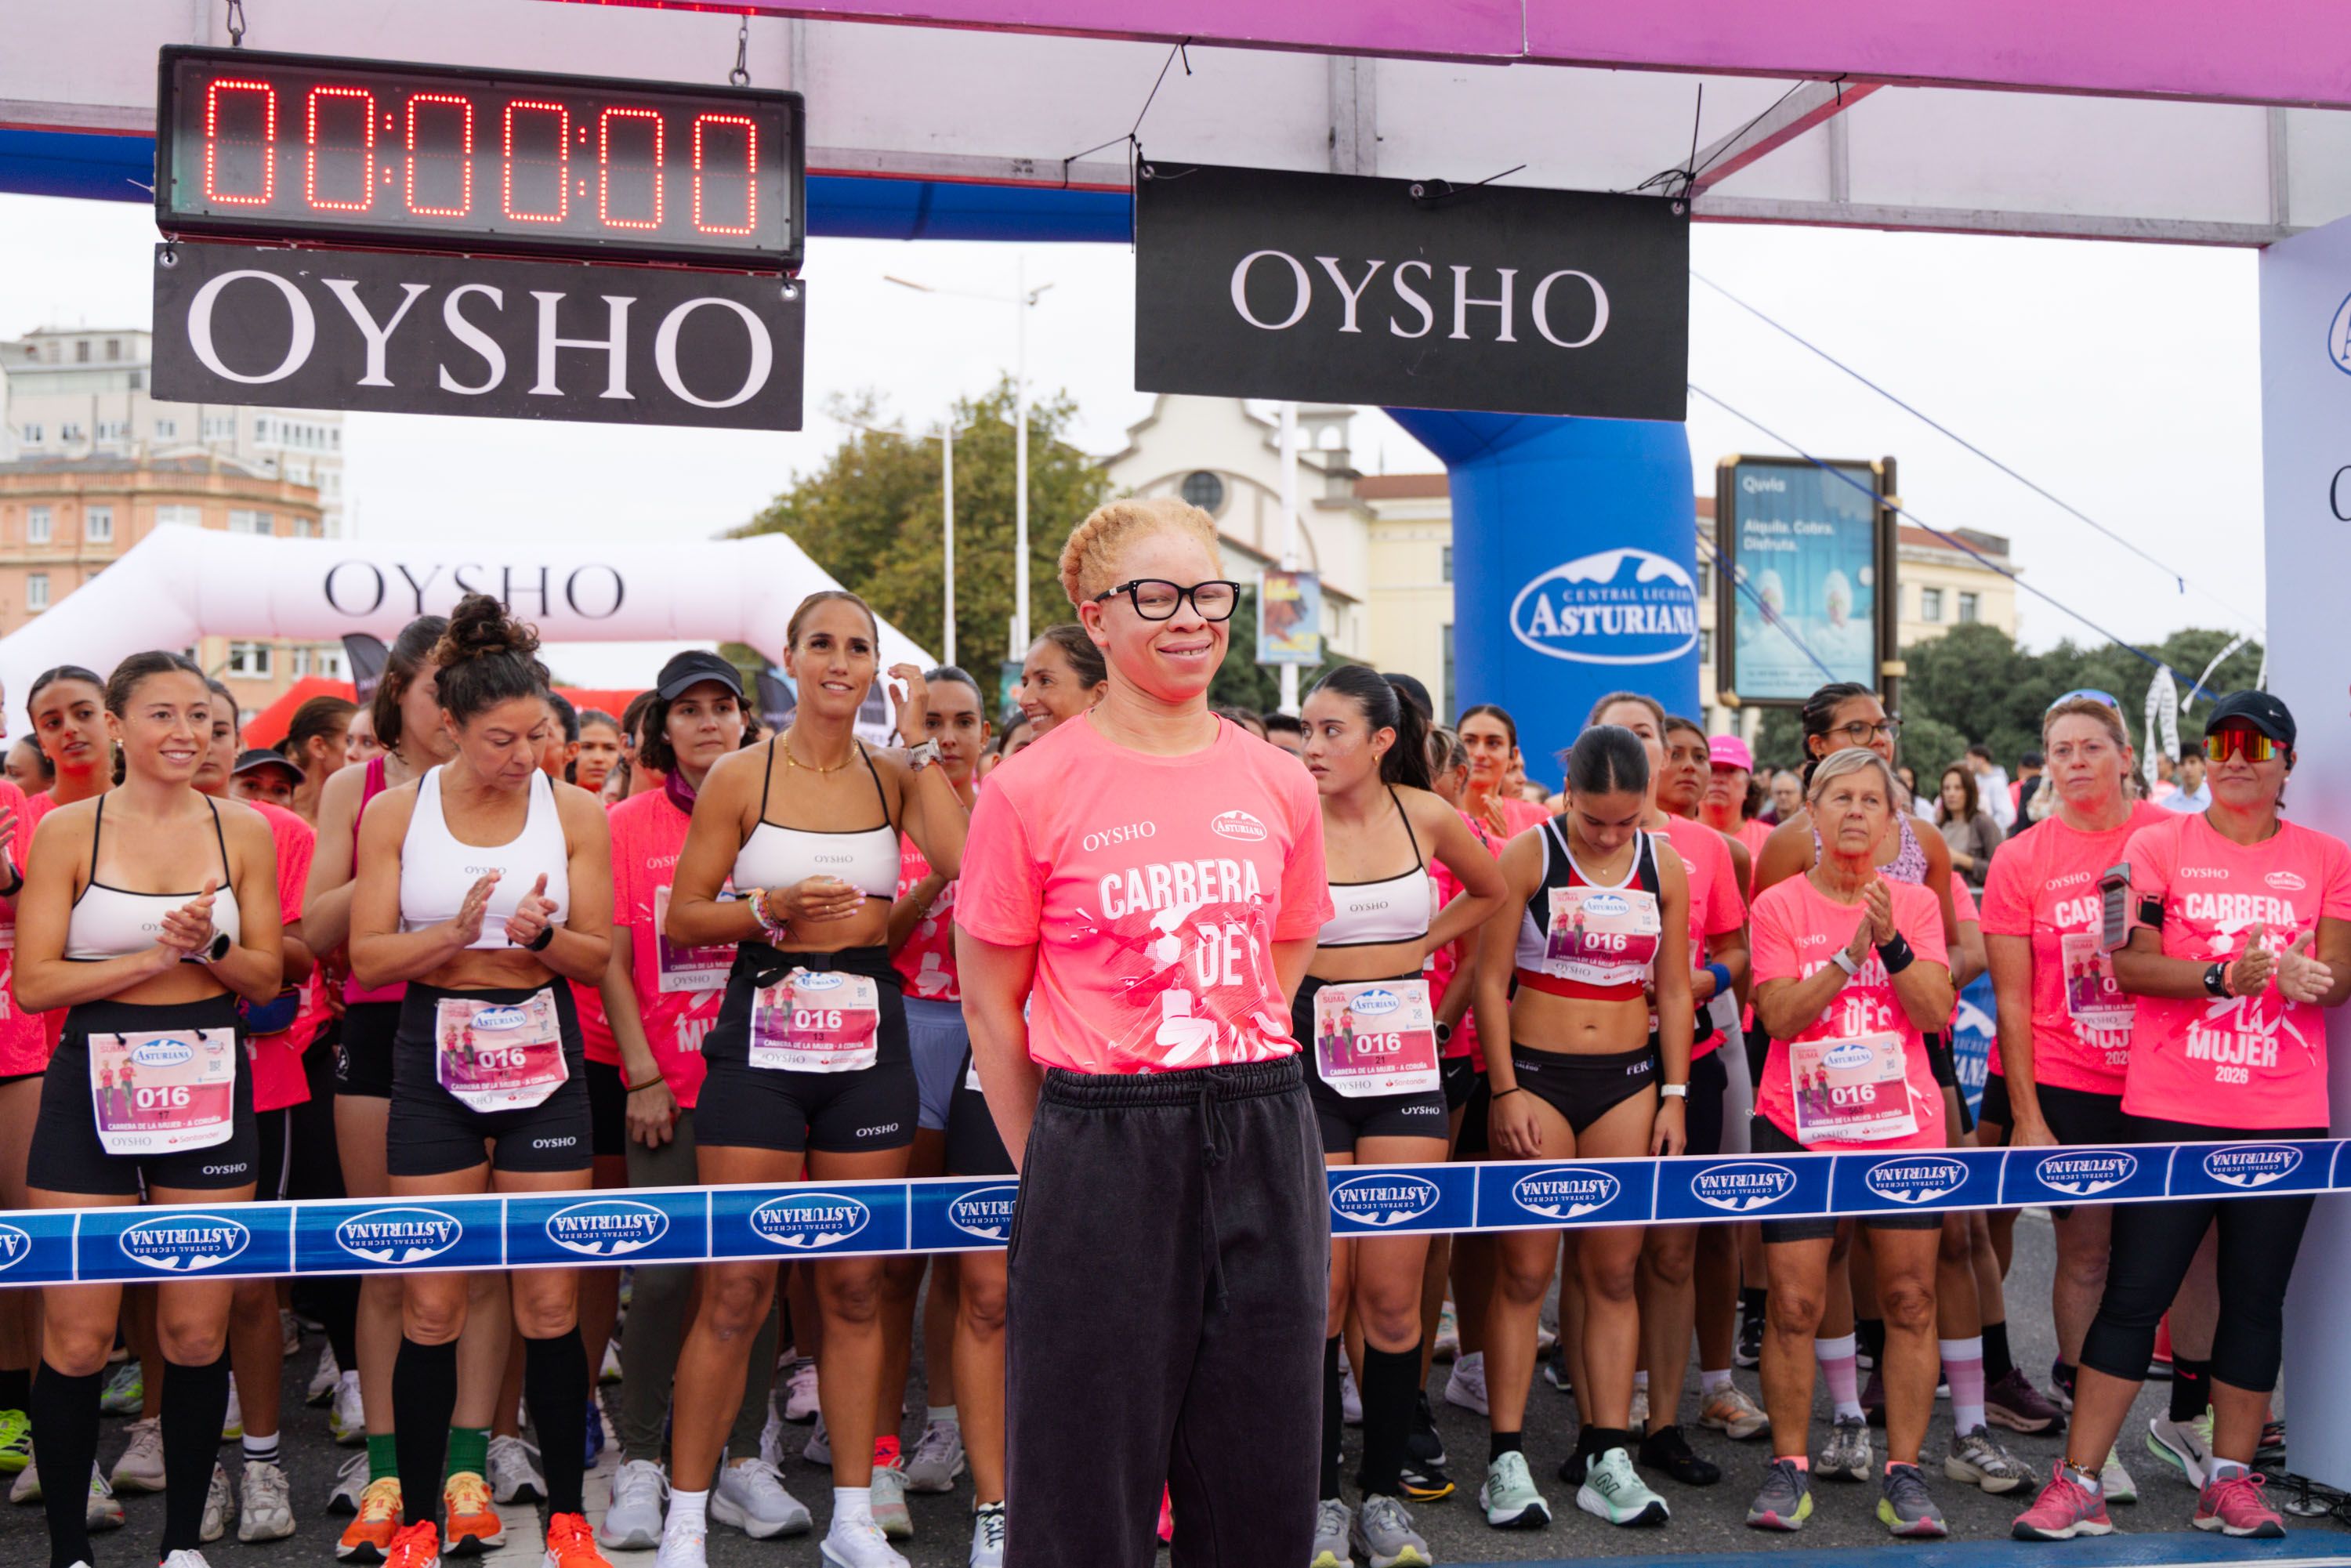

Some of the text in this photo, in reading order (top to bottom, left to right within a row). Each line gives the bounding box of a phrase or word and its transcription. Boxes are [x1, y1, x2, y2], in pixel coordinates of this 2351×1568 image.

[1230, 249, 1610, 349] OYSHO
[187, 269, 774, 409] OYSHO
[1744, 519, 1836, 535] Alquila. Cobra.
[1744, 536, 1798, 552] Disfruta.
[1562, 588, 1639, 603] CENTRAL
[1083, 820, 1156, 852] OYSHO
[1216, 820, 1264, 837] ASTURIANA
[2045, 871, 2091, 890] OYSHO
[2181, 867, 2229, 878] OYSHO
[1099, 858, 1262, 921] CARRERA
[1349, 901, 1389, 912] OYSHO
[1586, 902, 1627, 911] ASTURIANA
[2186, 893, 2298, 928] CARRERA
[1585, 932, 1627, 951] 016
[1196, 921, 1248, 987] DE
[1556, 963, 1591, 976] OYSHO
[673, 976, 710, 987] OYSHO
[1354, 1000, 1396, 1010] ASTURIANA
[476, 1014, 526, 1027] ASTURIANA
[795, 1010, 842, 1029] 016
[1844, 995, 1878, 1036] DE
[2235, 996, 2263, 1034] LA
[813, 1033, 824, 1041] 13
[1357, 1033, 1401, 1053] 016
[136, 1049, 190, 1061] ASTURIANA
[2186, 1029, 2279, 1067] MUJER
[478, 1048, 527, 1069] 016
[1515, 1062, 1539, 1072] GALEGO
[1828, 1053, 1871, 1065] ASTURIANA
[1376, 1065, 1396, 1074] MUJER
[2215, 1065, 2249, 1085] 2026
[1334, 1081, 1371, 1090] OYSHO
[1831, 1084, 1876, 1105] 016
[136, 1086, 190, 1108] 016
[158, 1110, 169, 1120] 17
[179, 1131, 219, 1143] Santander
[856, 1123, 899, 1137] OYSHO
[111, 1137, 151, 1146] OYSHO
[533, 1136, 577, 1149] OYSHO
[203, 1163, 247, 1175] OYSHO
[2045, 1157, 2132, 1177] ASTURIANA
[2212, 1150, 2297, 1169] ASTURIANA
[1700, 1171, 1790, 1193] ASTURIANA
[1874, 1165, 1962, 1185] ASTURIANA
[1338, 1185, 1433, 1206] ASTURIANA
[1521, 1179, 1614, 1199] ASTURIANA
[556, 1213, 661, 1235] ASTURIANA
[759, 1206, 861, 1228] ASTURIANA
[130, 1228, 241, 1251] ASTURIANA
[346, 1221, 453, 1243] ASTURIANA
